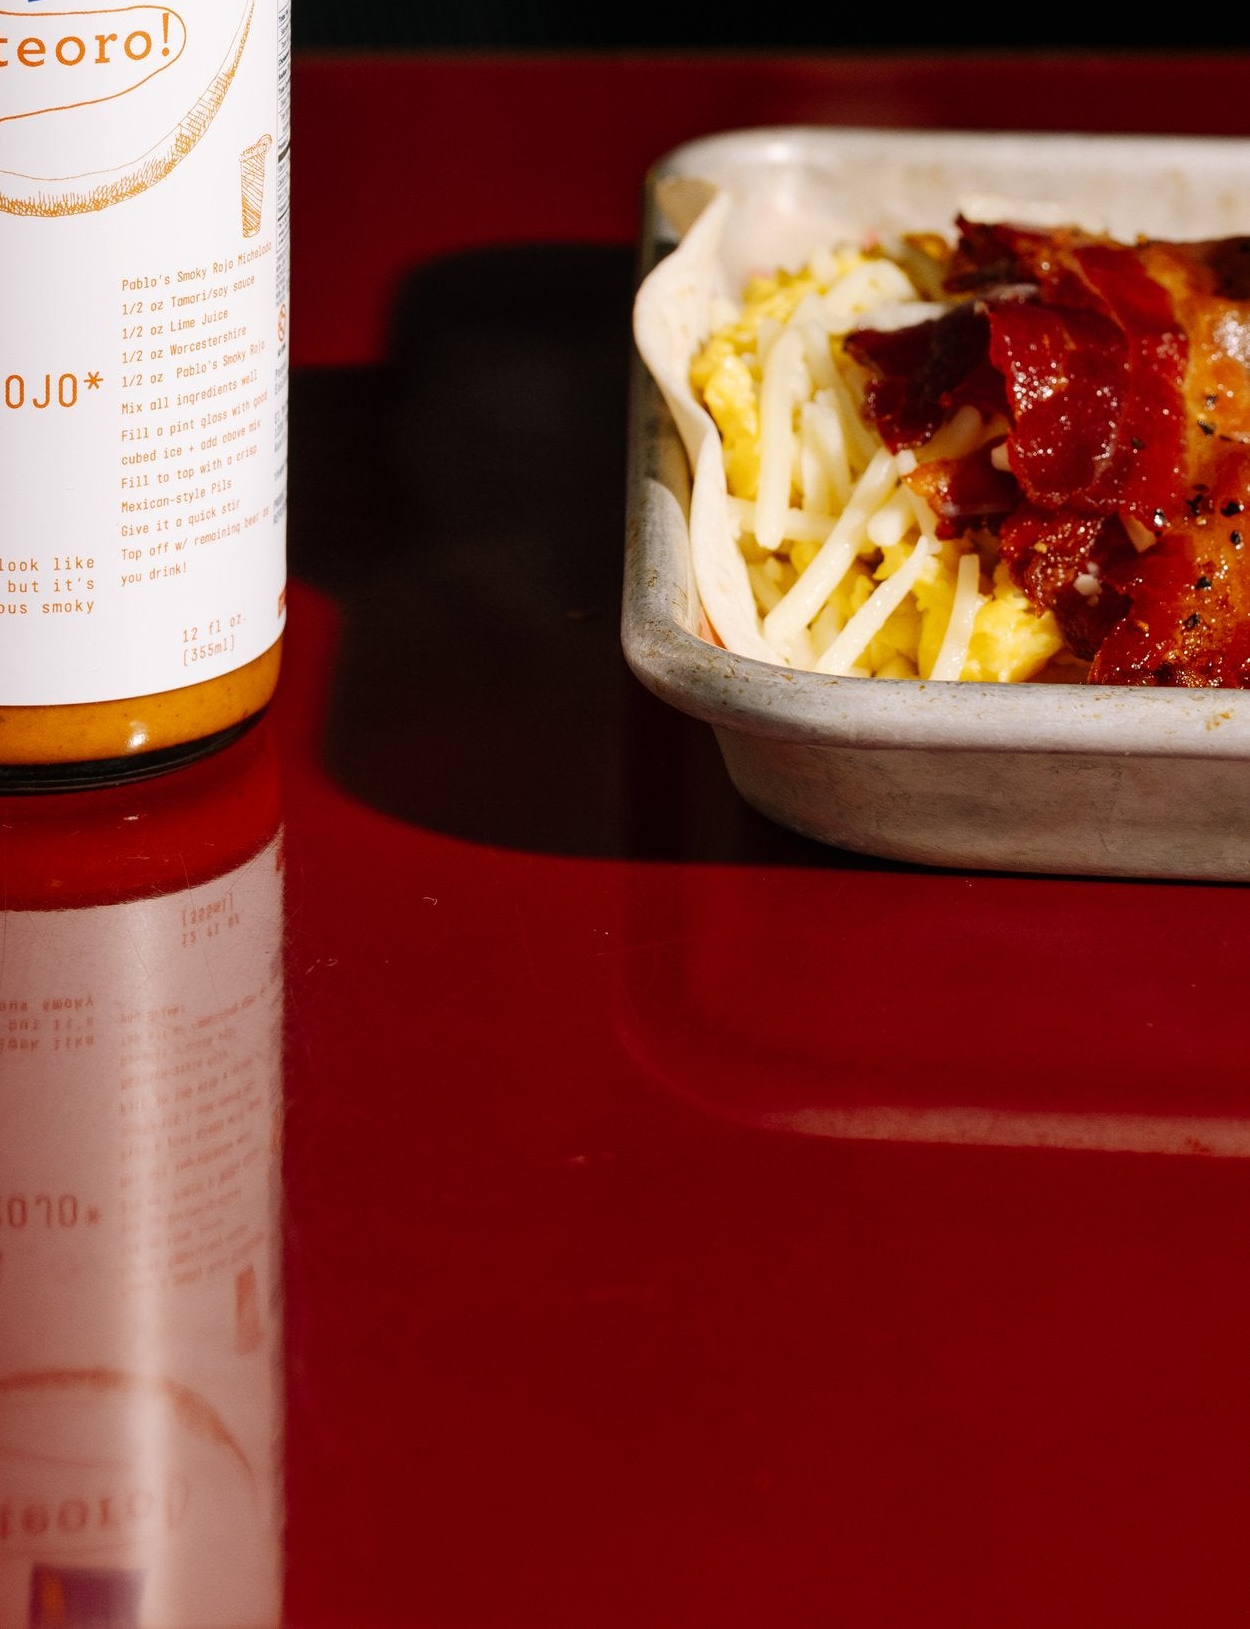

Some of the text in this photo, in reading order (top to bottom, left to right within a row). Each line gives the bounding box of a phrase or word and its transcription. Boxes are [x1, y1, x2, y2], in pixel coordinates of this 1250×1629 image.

[121, 275, 171, 291] Pablo's
[177, 267, 207, 284] Smoky
[212, 258, 234, 274] Rojo
[121, 275, 256, 316] 1/2 oz Tamari/soy sauce
[121, 308, 229, 340] 1/2 oz Lime Juice
[121, 325, 247, 364] 1/2 oz Worcestershire
[121, 374, 143, 388] 1/2
[150, 373, 164, 384] oz
[176, 361, 218, 379] Pablo's
[222, 349, 247, 367] Smoky
[121, 369, 258, 415] Mix all ingredients well
[121, 428, 149, 442] Fill
[157, 428, 164, 437] a
[170, 420, 195, 435] pint
[200, 410, 228, 430] glass
[231, 400, 251, 417] with
[121, 450, 157, 466] cubed
[164, 446, 183, 459] ice
[201, 437, 218, 451] add
[222, 427, 246, 447] above
[121, 444, 258, 489] Fill to top with a crisp
[121, 479, 232, 514] Mexican-style Pils
[121, 499, 241, 537] Give it a quick stir
[121, 547, 142, 561] Top
[150, 542, 169, 557] off
[175, 538, 188, 552] w/
[194, 521, 241, 546] remaining
[53, 557, 95, 571] like
[121, 562, 188, 587] you drink!
[8, 579, 39, 593] but
[53, 577, 94, 592] it's
[42, 599, 95, 615] smoky
[183, 627, 198, 643] 12
[208, 621, 221, 636] fl
